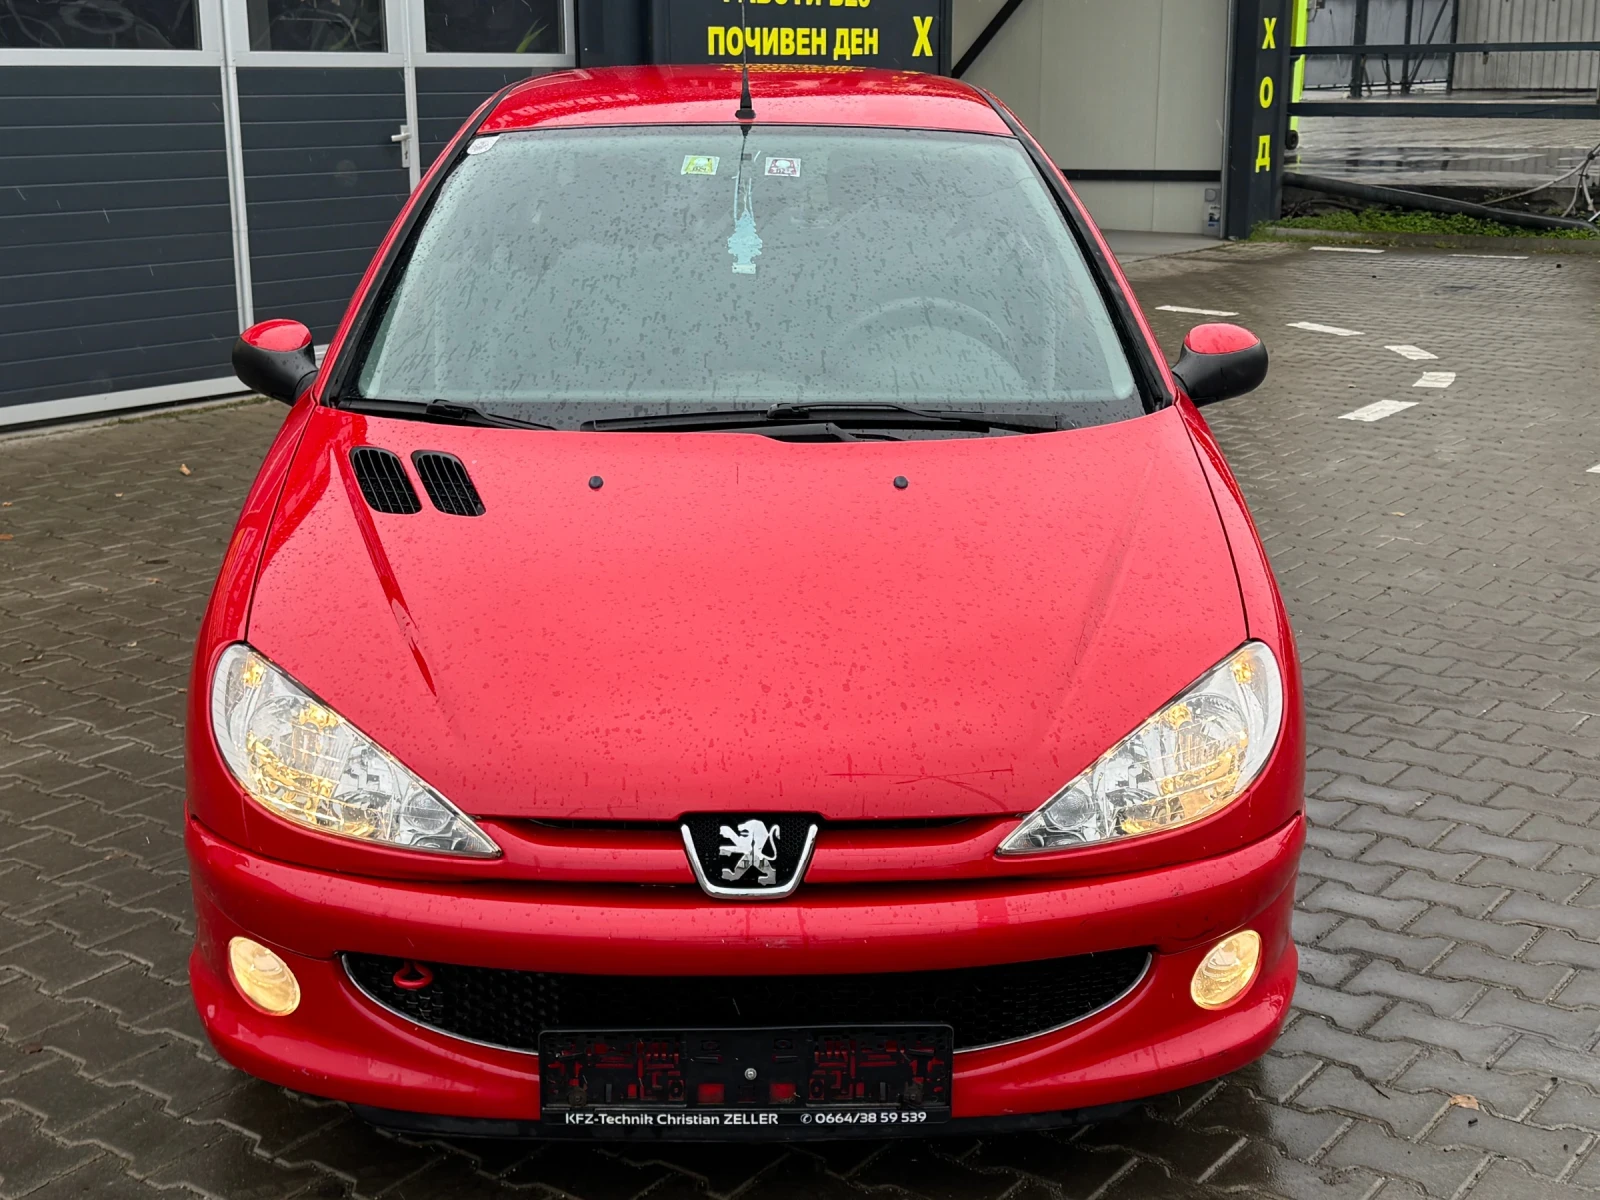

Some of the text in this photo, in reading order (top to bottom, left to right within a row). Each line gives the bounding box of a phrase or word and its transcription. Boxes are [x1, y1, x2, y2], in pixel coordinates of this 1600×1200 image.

[707, 26, 879, 61] ПОЧИВЕН ДЕН
[565, 1113, 779, 1125] KFZ-Technik Christian ZELLER
[815, 1111, 927, 1124] 0664/38 59 539
